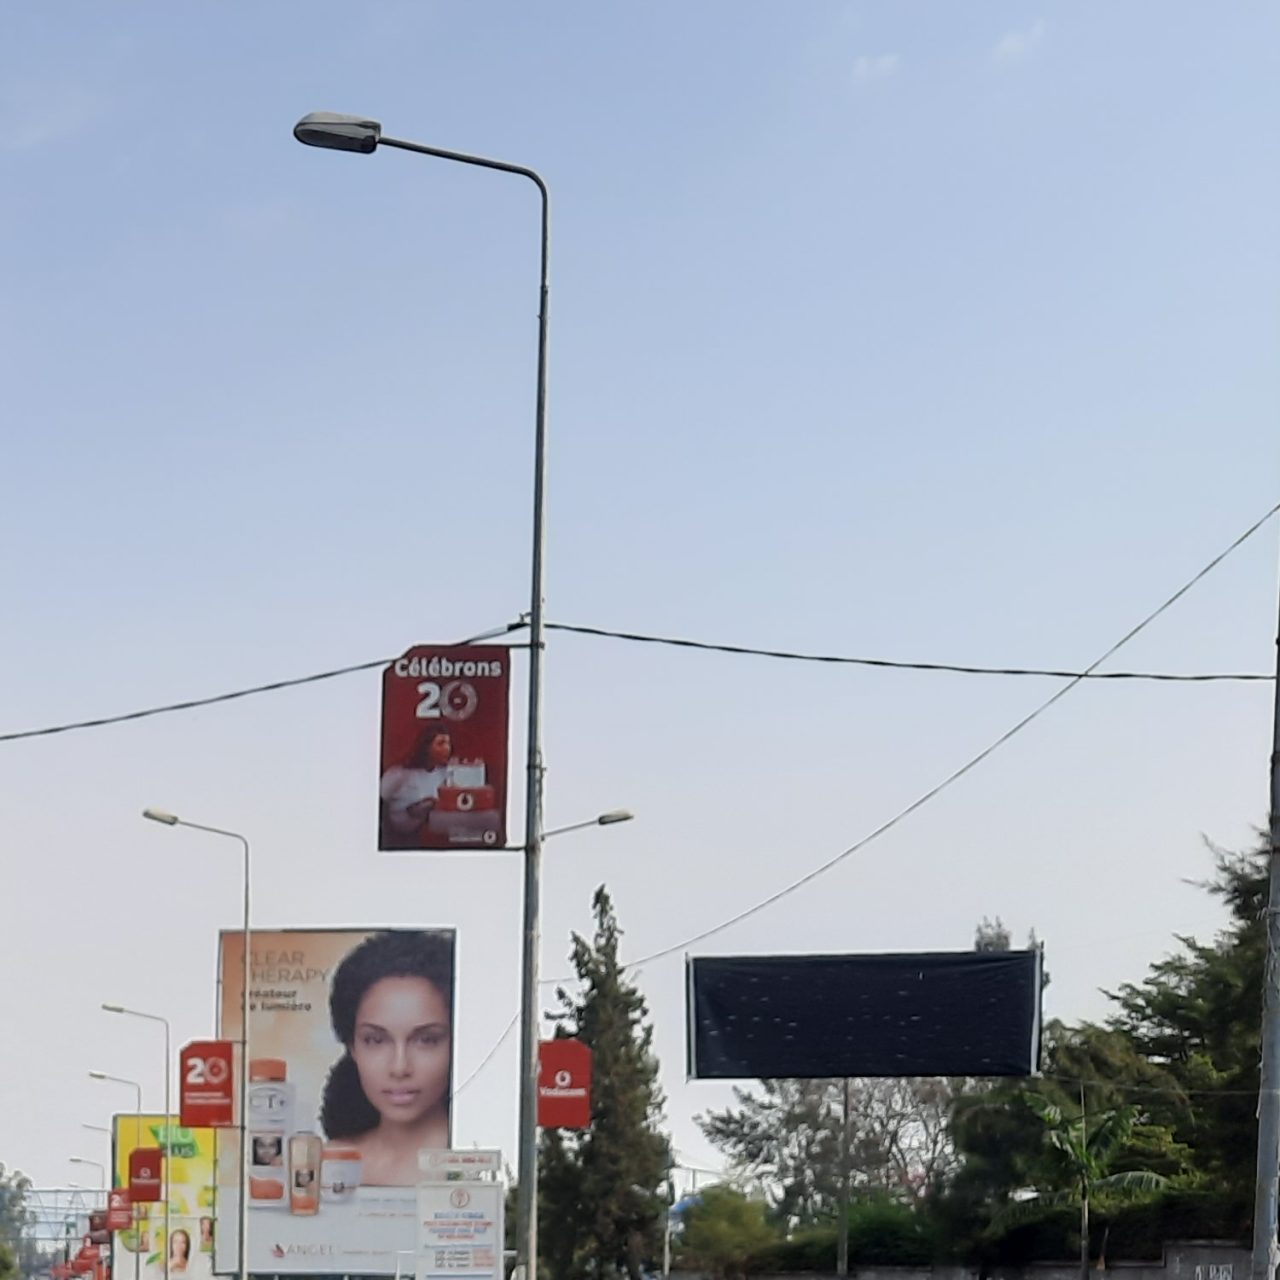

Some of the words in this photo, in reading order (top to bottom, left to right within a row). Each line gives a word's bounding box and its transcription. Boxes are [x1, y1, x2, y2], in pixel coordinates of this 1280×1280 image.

[394, 657, 503, 678] Célébrons
[242, 950, 305, 966] LEAR
[242, 968, 330, 983] HERAPY
